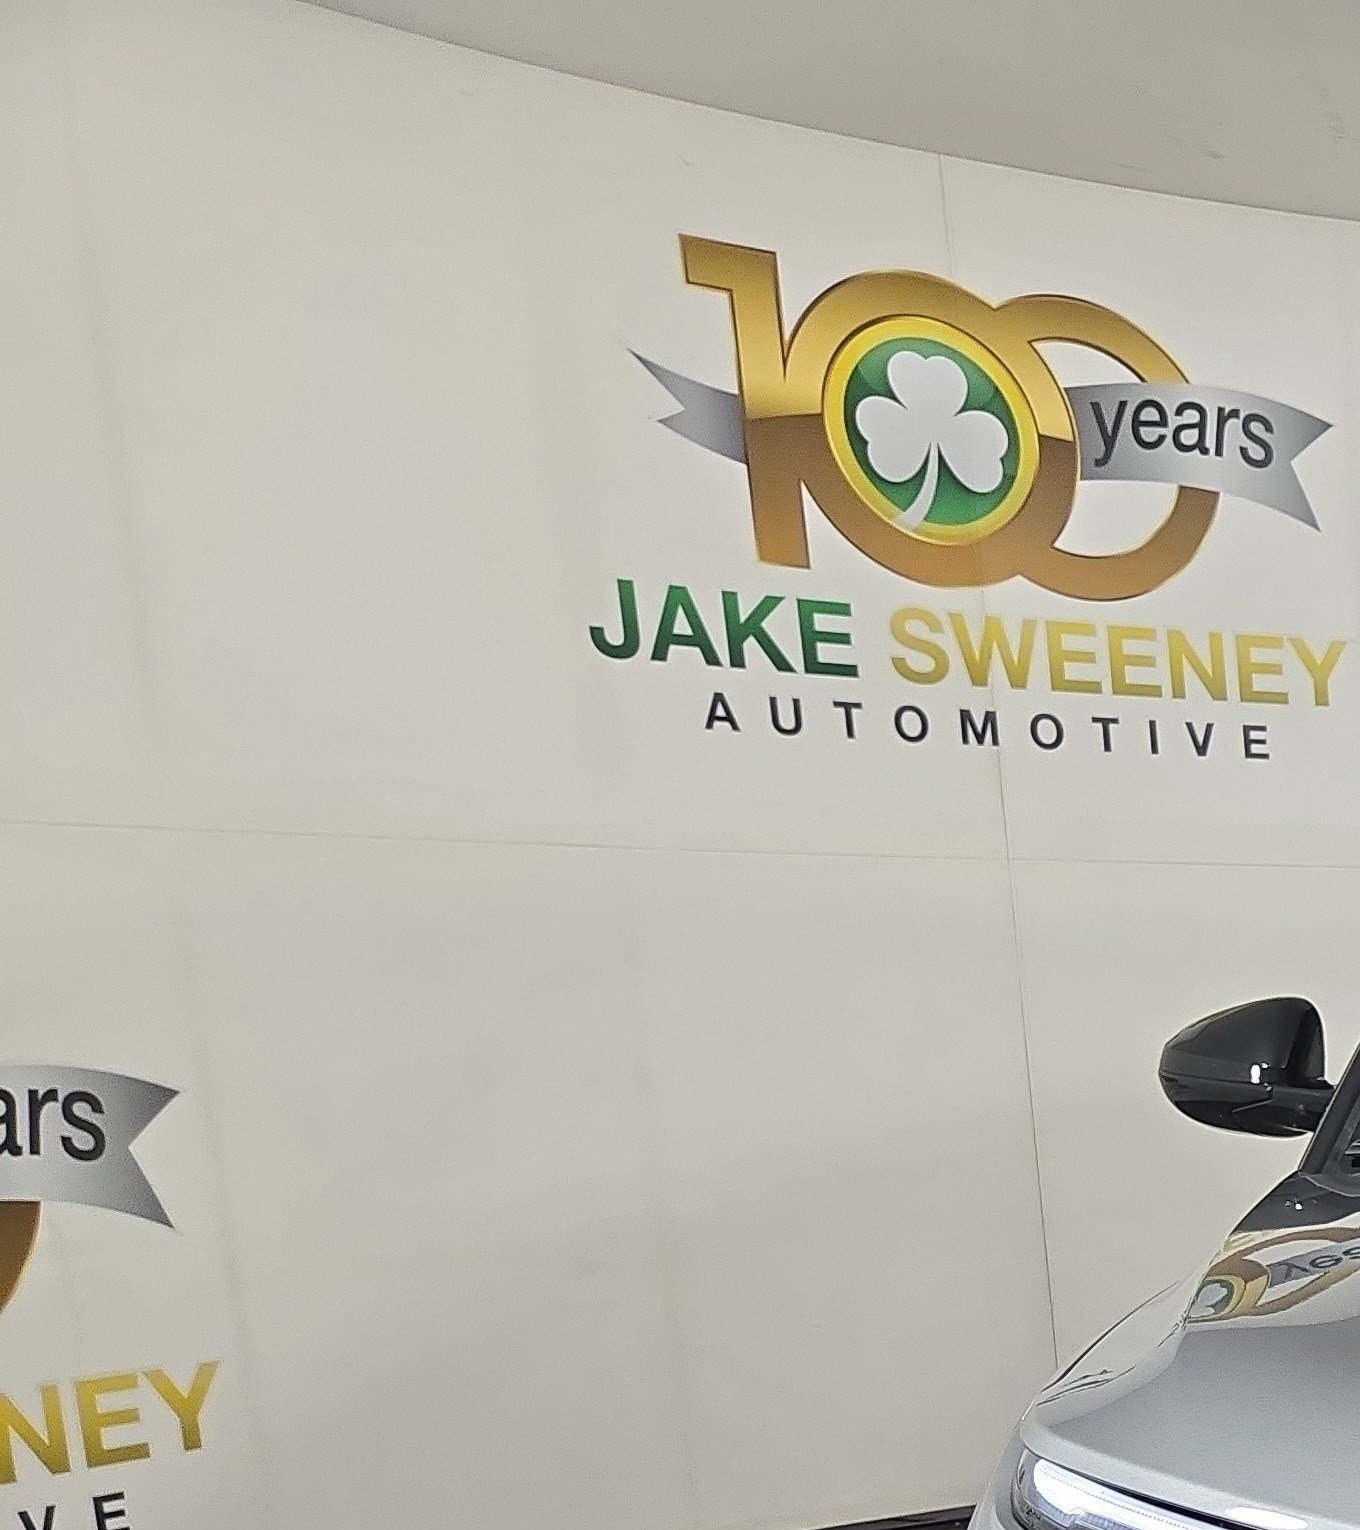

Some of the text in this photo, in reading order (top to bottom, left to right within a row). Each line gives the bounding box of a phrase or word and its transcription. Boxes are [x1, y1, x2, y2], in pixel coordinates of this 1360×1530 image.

[678, 233, 1220, 602] 100
[1090, 399, 1275, 469] years
[588, 578, 1348, 708] JAKE SWEENEY
[704, 692, 1272, 760] AUTOMOTIVE
